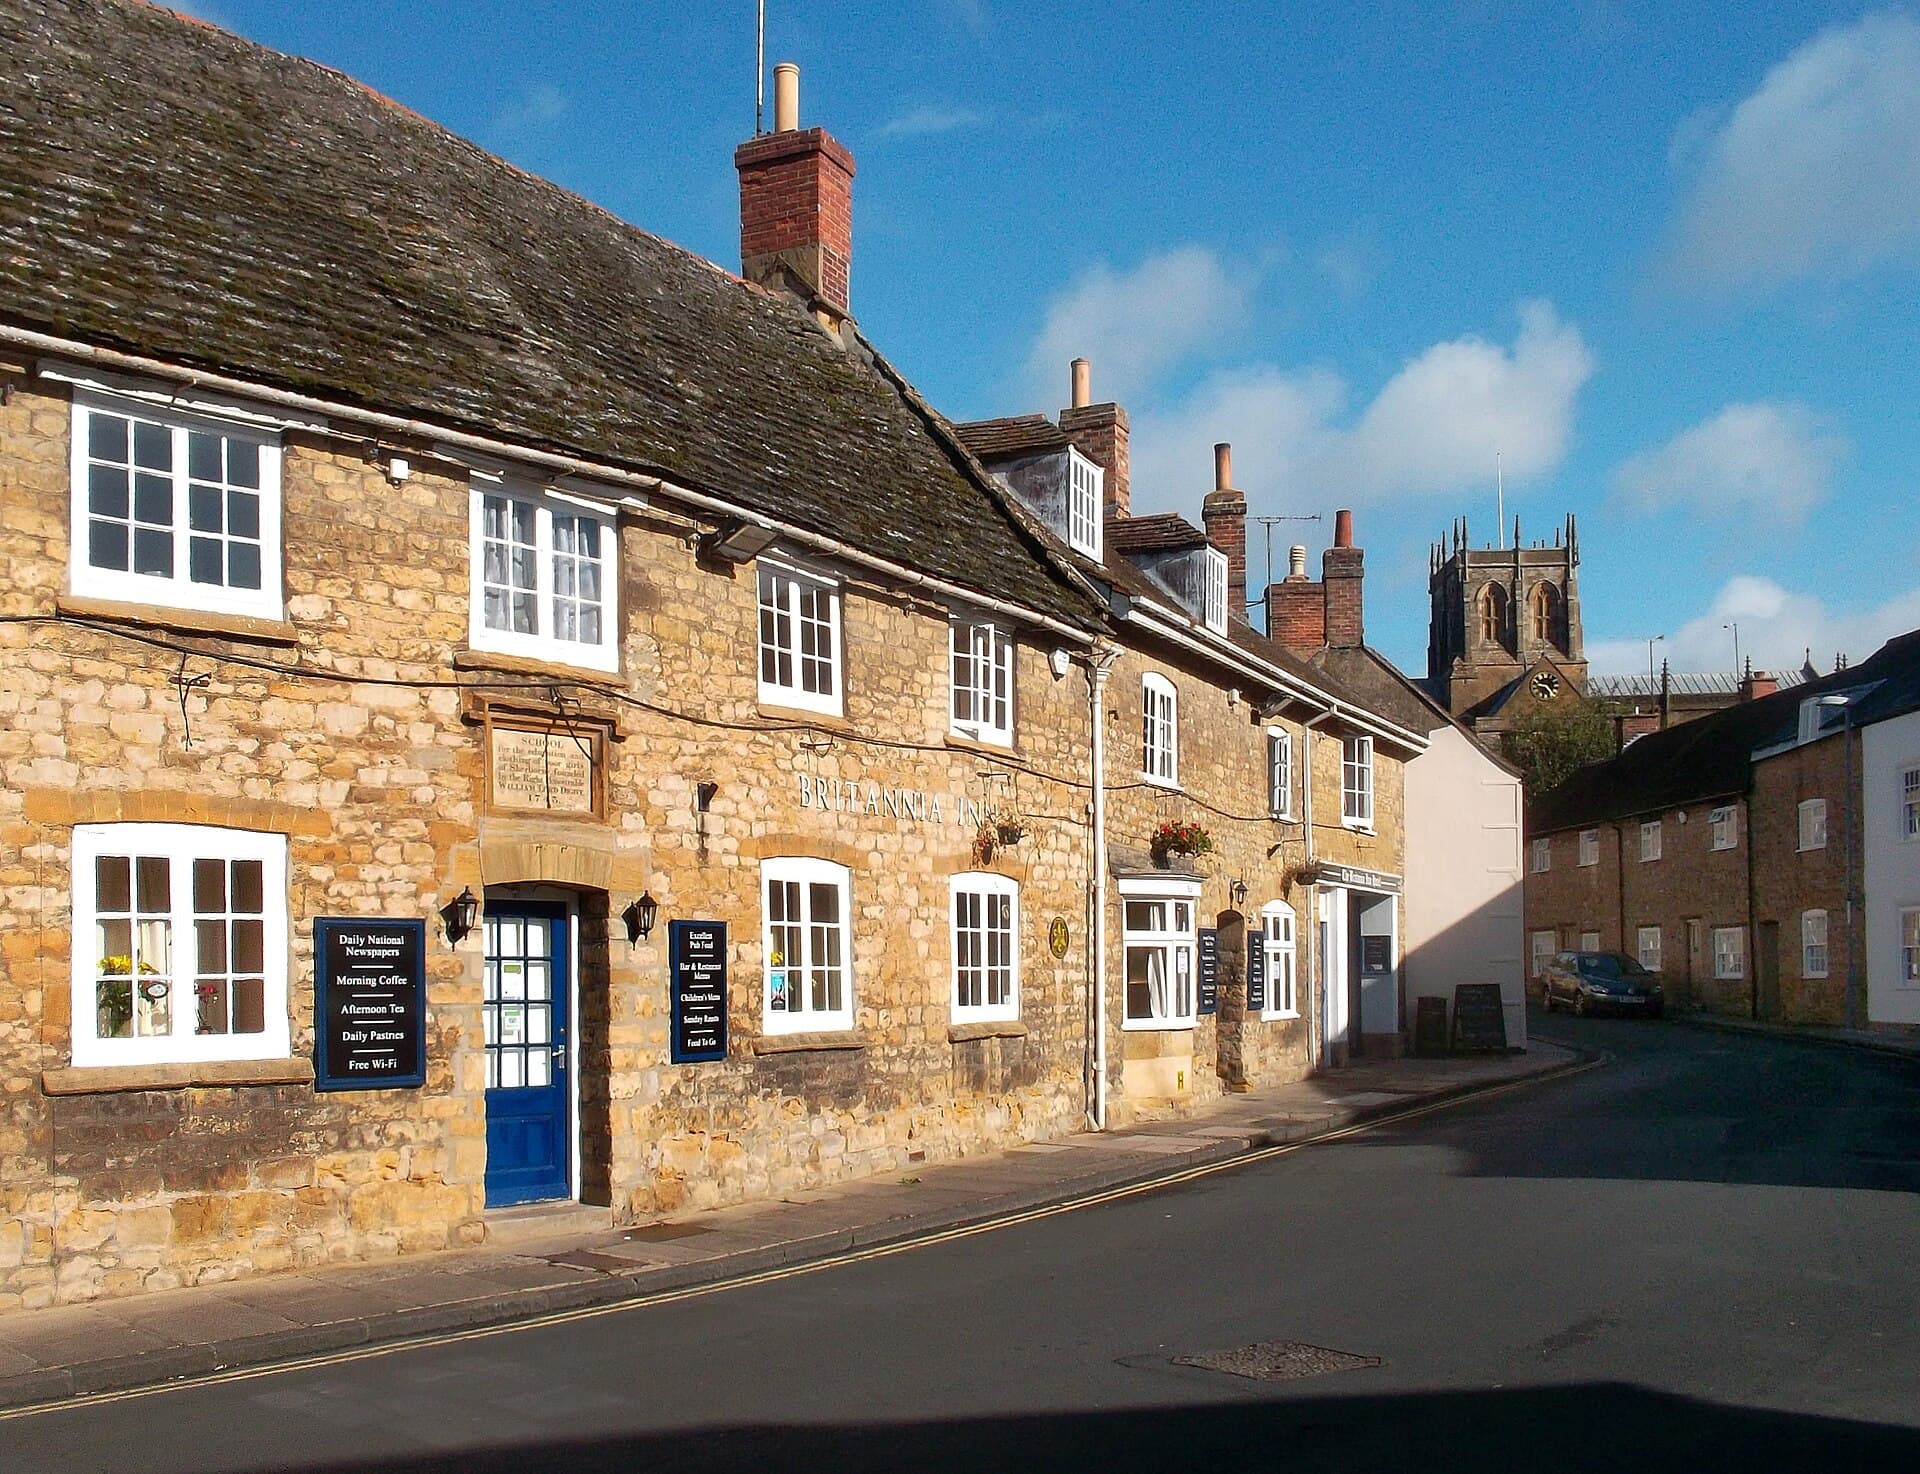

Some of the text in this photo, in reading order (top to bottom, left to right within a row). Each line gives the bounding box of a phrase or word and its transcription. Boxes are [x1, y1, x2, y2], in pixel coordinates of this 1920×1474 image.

[799, 776, 999, 827] BRITANNIA INN
[339, 934, 404, 947] Daily National
[345, 946, 400, 959] Newspapers
[336, 975, 408, 988] Morning Coffee
[341, 1004, 405, 1015] Afternoon Tea
[342, 1030, 405, 1043] Daily Pastries
[687, 1037, 717, 1047] Food To Go
[348, 1058, 398, 1070] Free Wi-Fi
